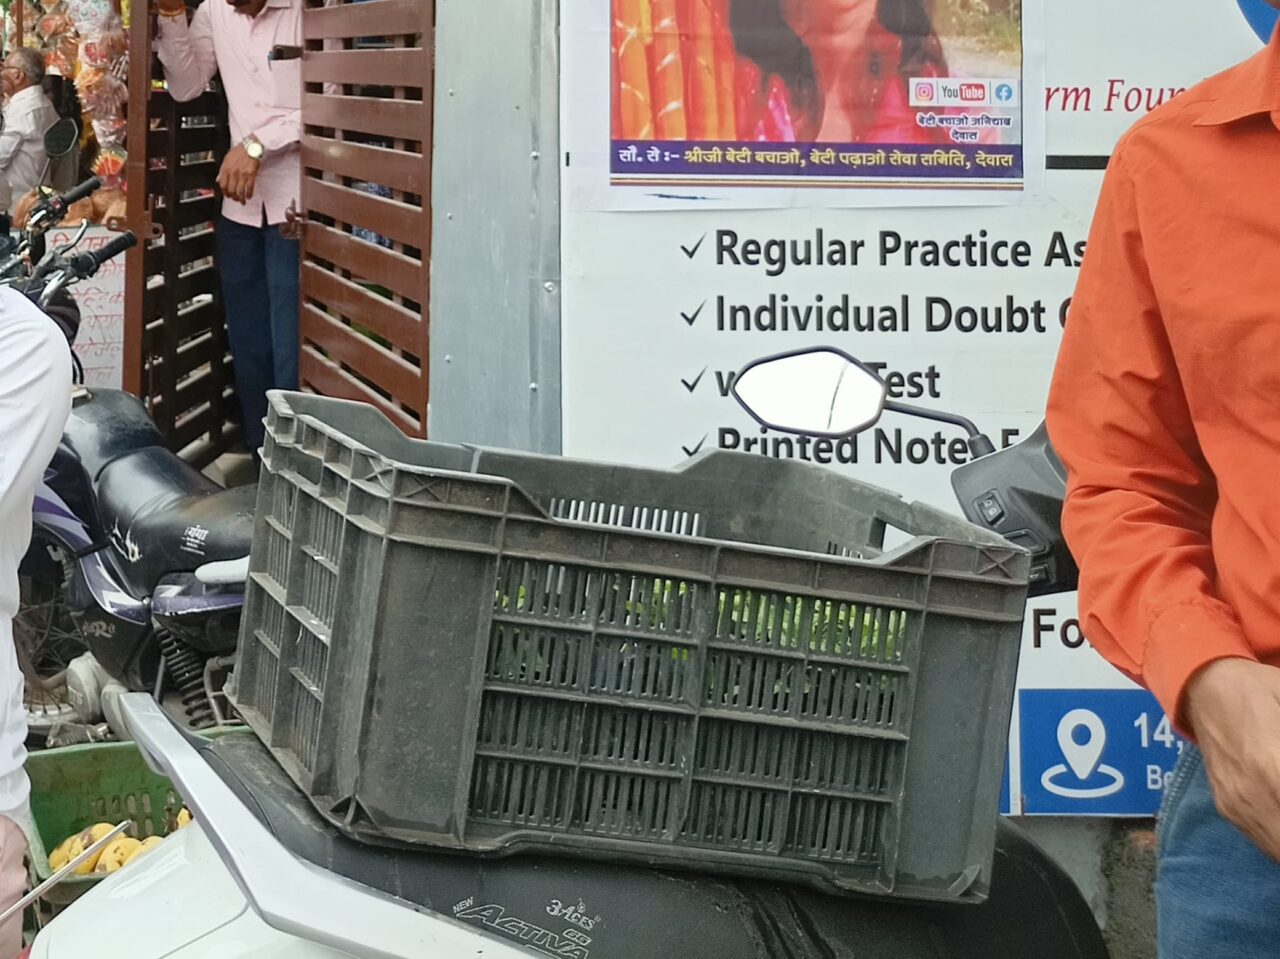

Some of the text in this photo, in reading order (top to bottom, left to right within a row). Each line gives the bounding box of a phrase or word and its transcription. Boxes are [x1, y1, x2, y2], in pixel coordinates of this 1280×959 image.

[684, 147, 722, 163] श्रीजी
[726, 147, 752, 163] बेटी
[755, 148, 806, 167] बचाओ,
[809, 149, 836, 164] बेटी
[839, 150, 886, 169] पढ़ाओ
[890, 150, 917, 165] सेवा
[920, 150, 970, 169] समिति,
[975, 151, 1014, 166] देवास
[715, 228, 864, 277] Regular
[879, 230, 1031, 267] Practice
[716, 294, 909, 332] Individual
[925, 296, 1046, 333] Doubt
[874, 428, 976, 465] Note
[1033, 608, 1094, 648] Fo
[452, 896, 474, 913] NEW
[456, 904, 589, 959] ACTIVA
